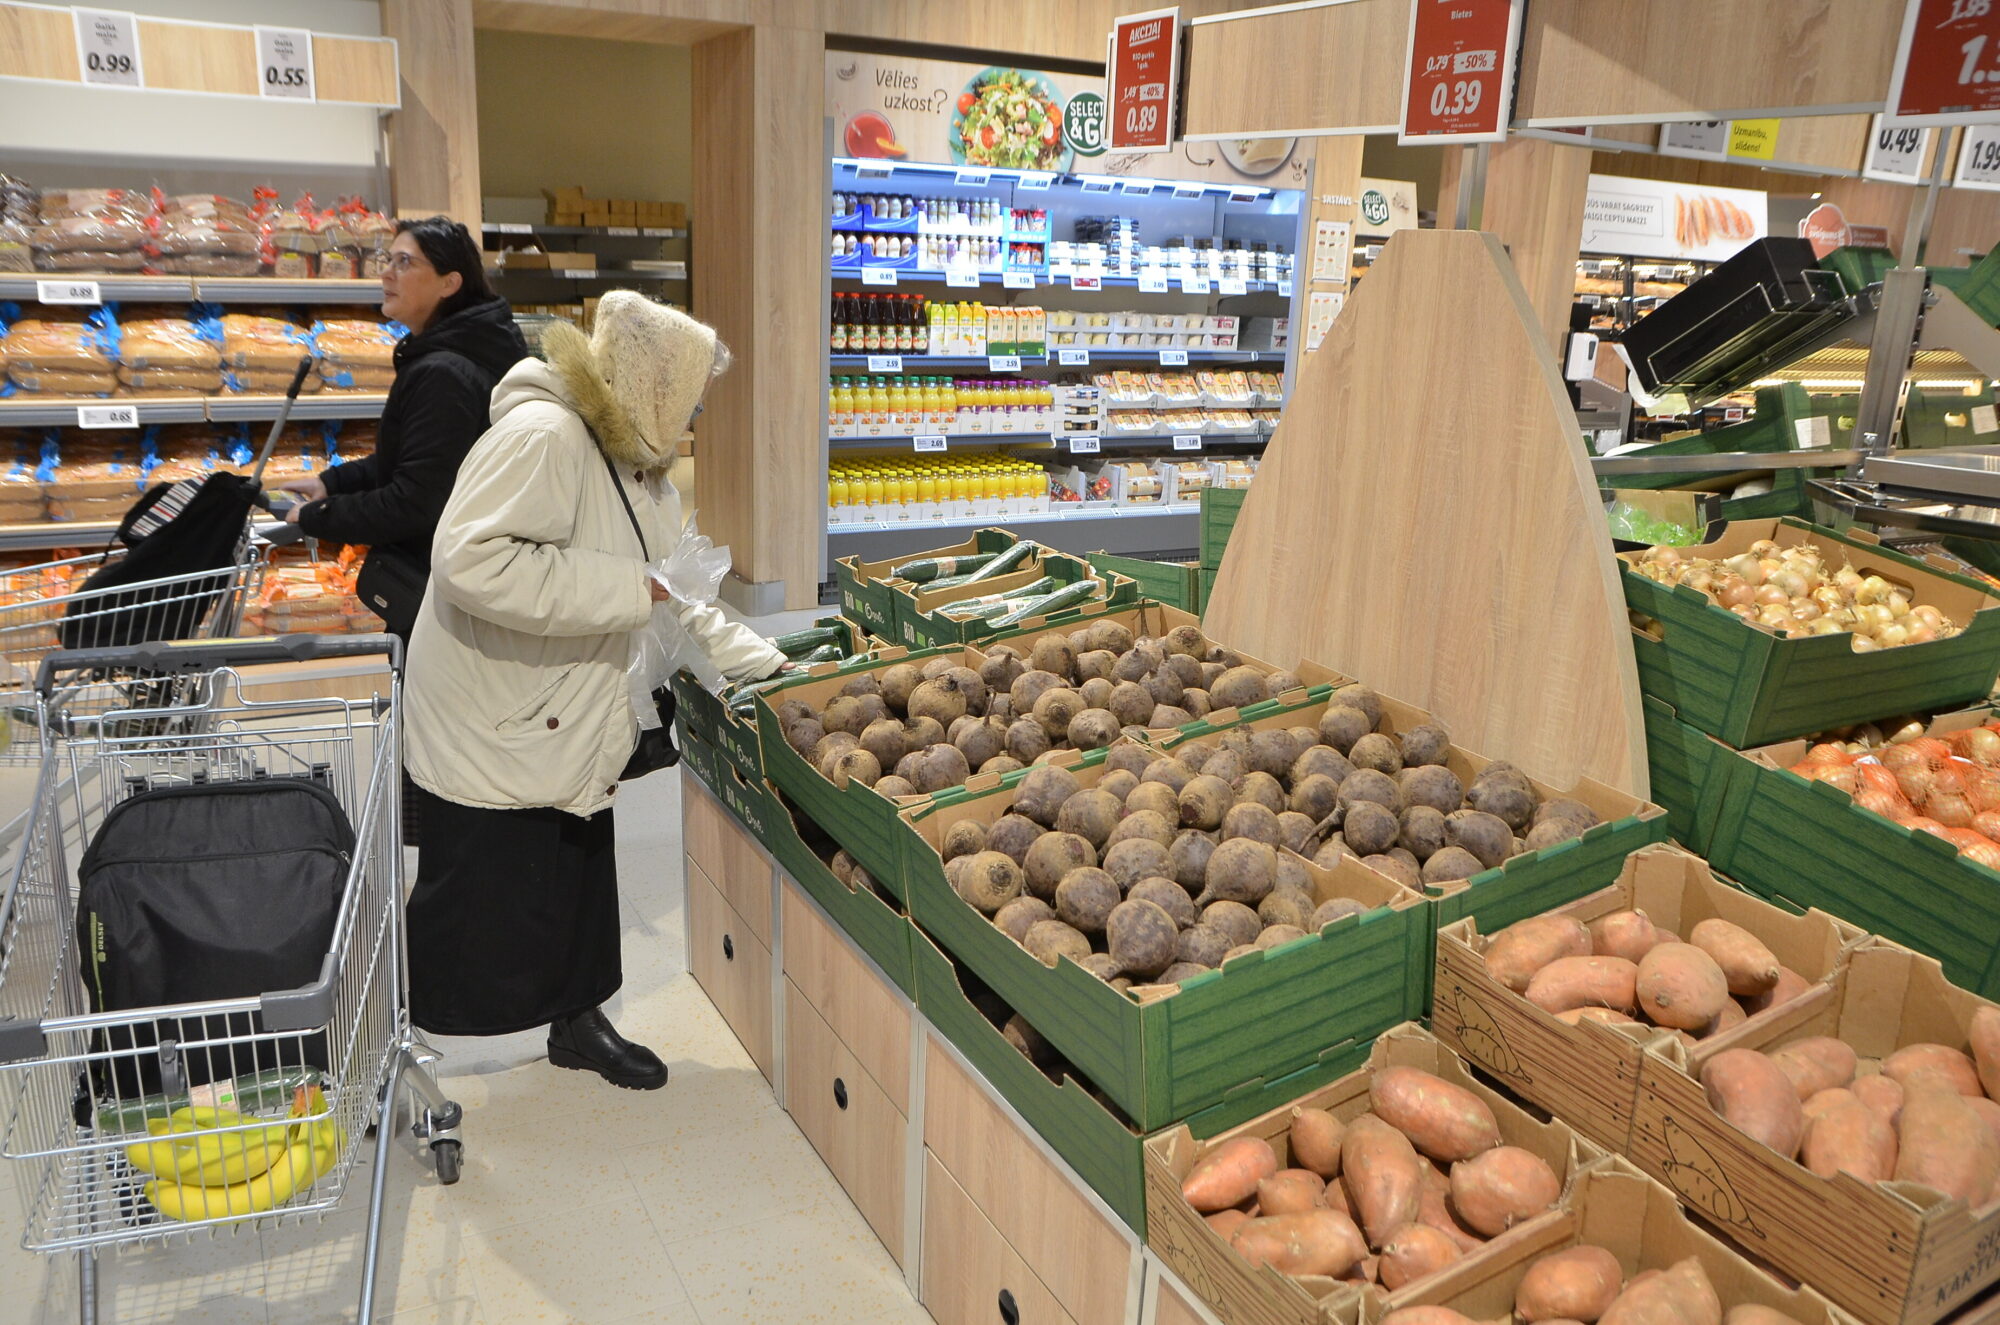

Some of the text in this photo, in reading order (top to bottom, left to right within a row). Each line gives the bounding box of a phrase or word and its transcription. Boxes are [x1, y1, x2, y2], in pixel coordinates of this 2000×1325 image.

[1451, 9, 1472, 20] Bietes
[1129, 20, 1162, 43] AKCIJA!
[1426, 54, 1488, 71] 0.79 -50%
[876, 68, 918, 89] Vēlies
[884, 88, 948, 114] uzkost?
[1070, 101, 1104, 117] SELECT
[1430, 80, 1482, 116] 0.39
[1126, 105, 1158, 133] 0.89
[1070, 117, 1104, 146] &G
